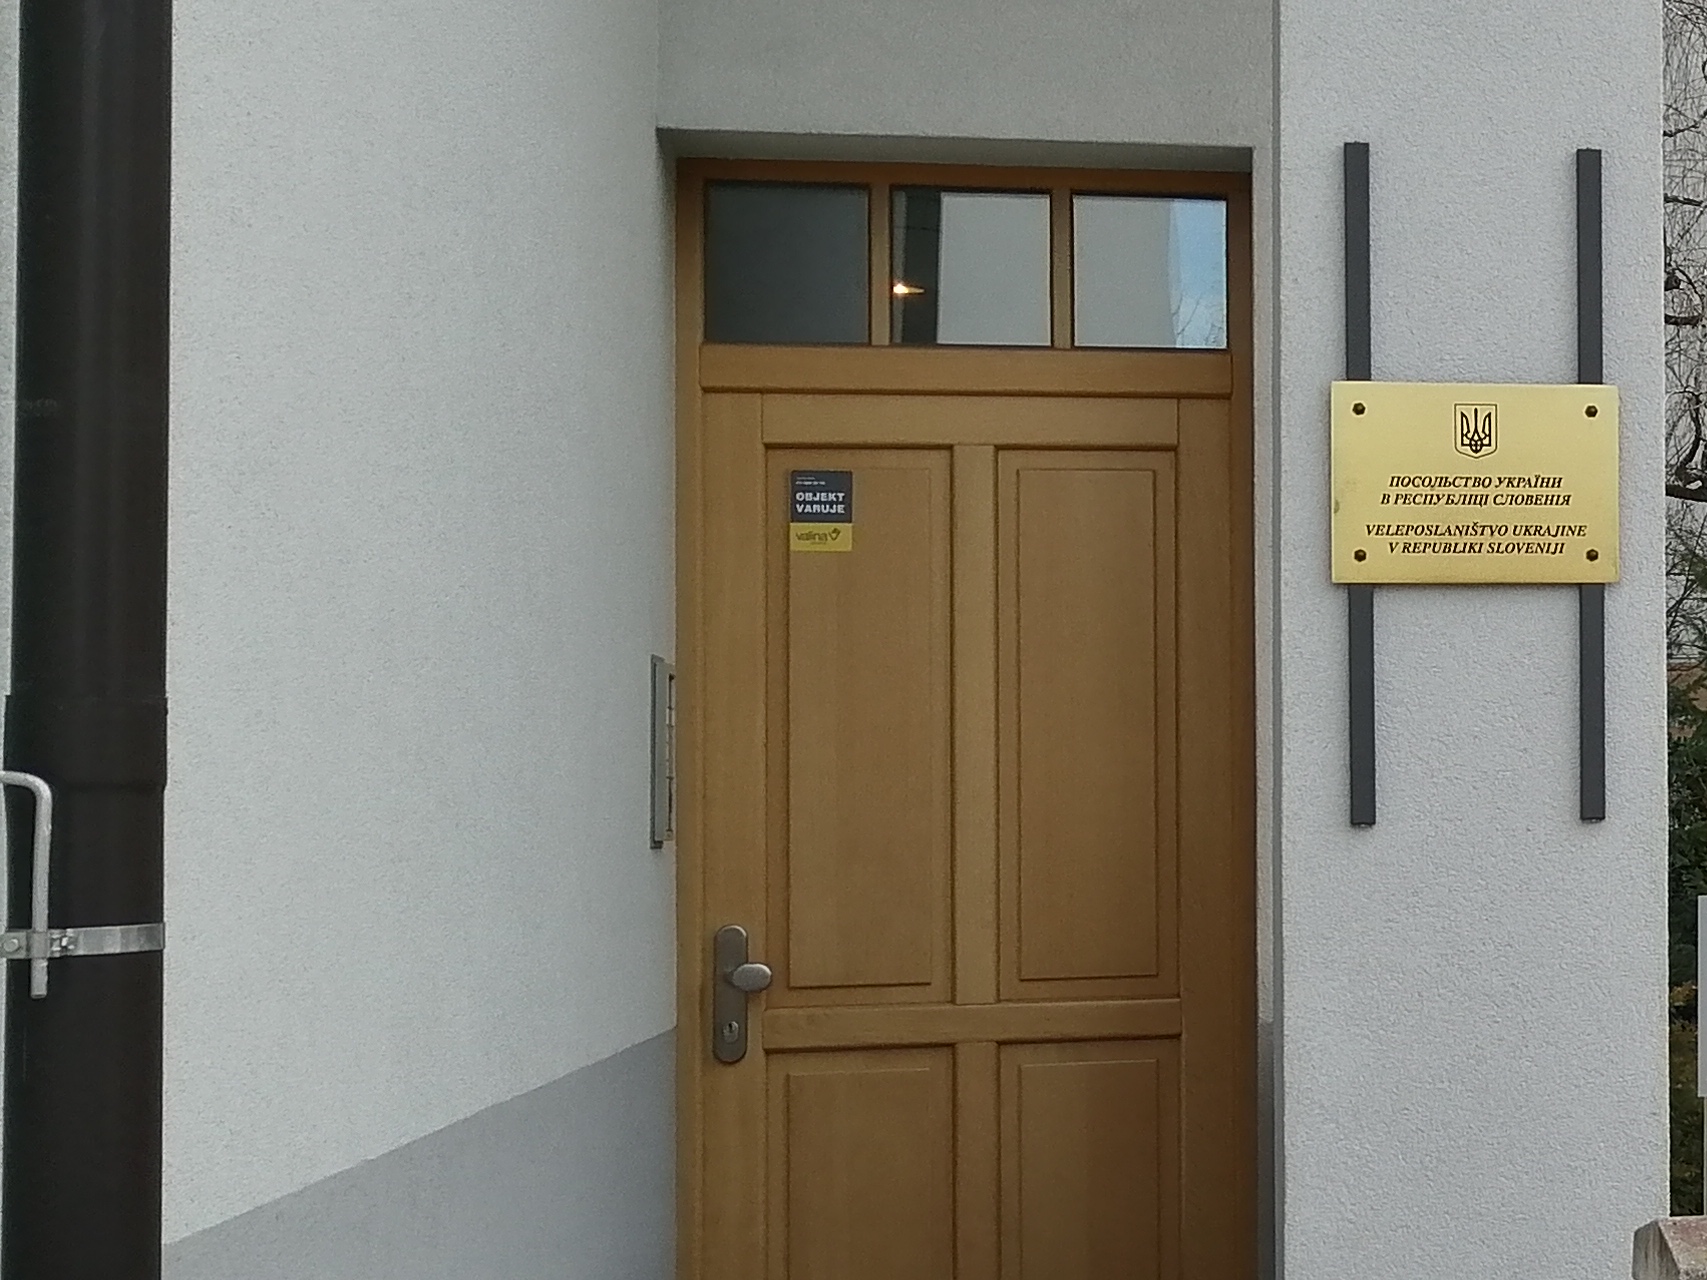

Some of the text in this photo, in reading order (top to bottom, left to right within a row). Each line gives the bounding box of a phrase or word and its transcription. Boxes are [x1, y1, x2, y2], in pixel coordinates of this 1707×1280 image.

[1389, 475, 1563, 489] ПОСОЛЬСТВО УКРАЇНИ
[796, 492, 845, 502] OBJEKT
[1380, 493, 1571, 507] В РЕСПУБЛІЦІ СЛОВЕНІЯ
[796, 504, 845, 514] VARUJE
[1366, 521, 1587, 537] VELEPOSLANIŠTVO UKRAJINE
[1388, 541, 1565, 554] V REPUBLIKI SLOVENIJI
